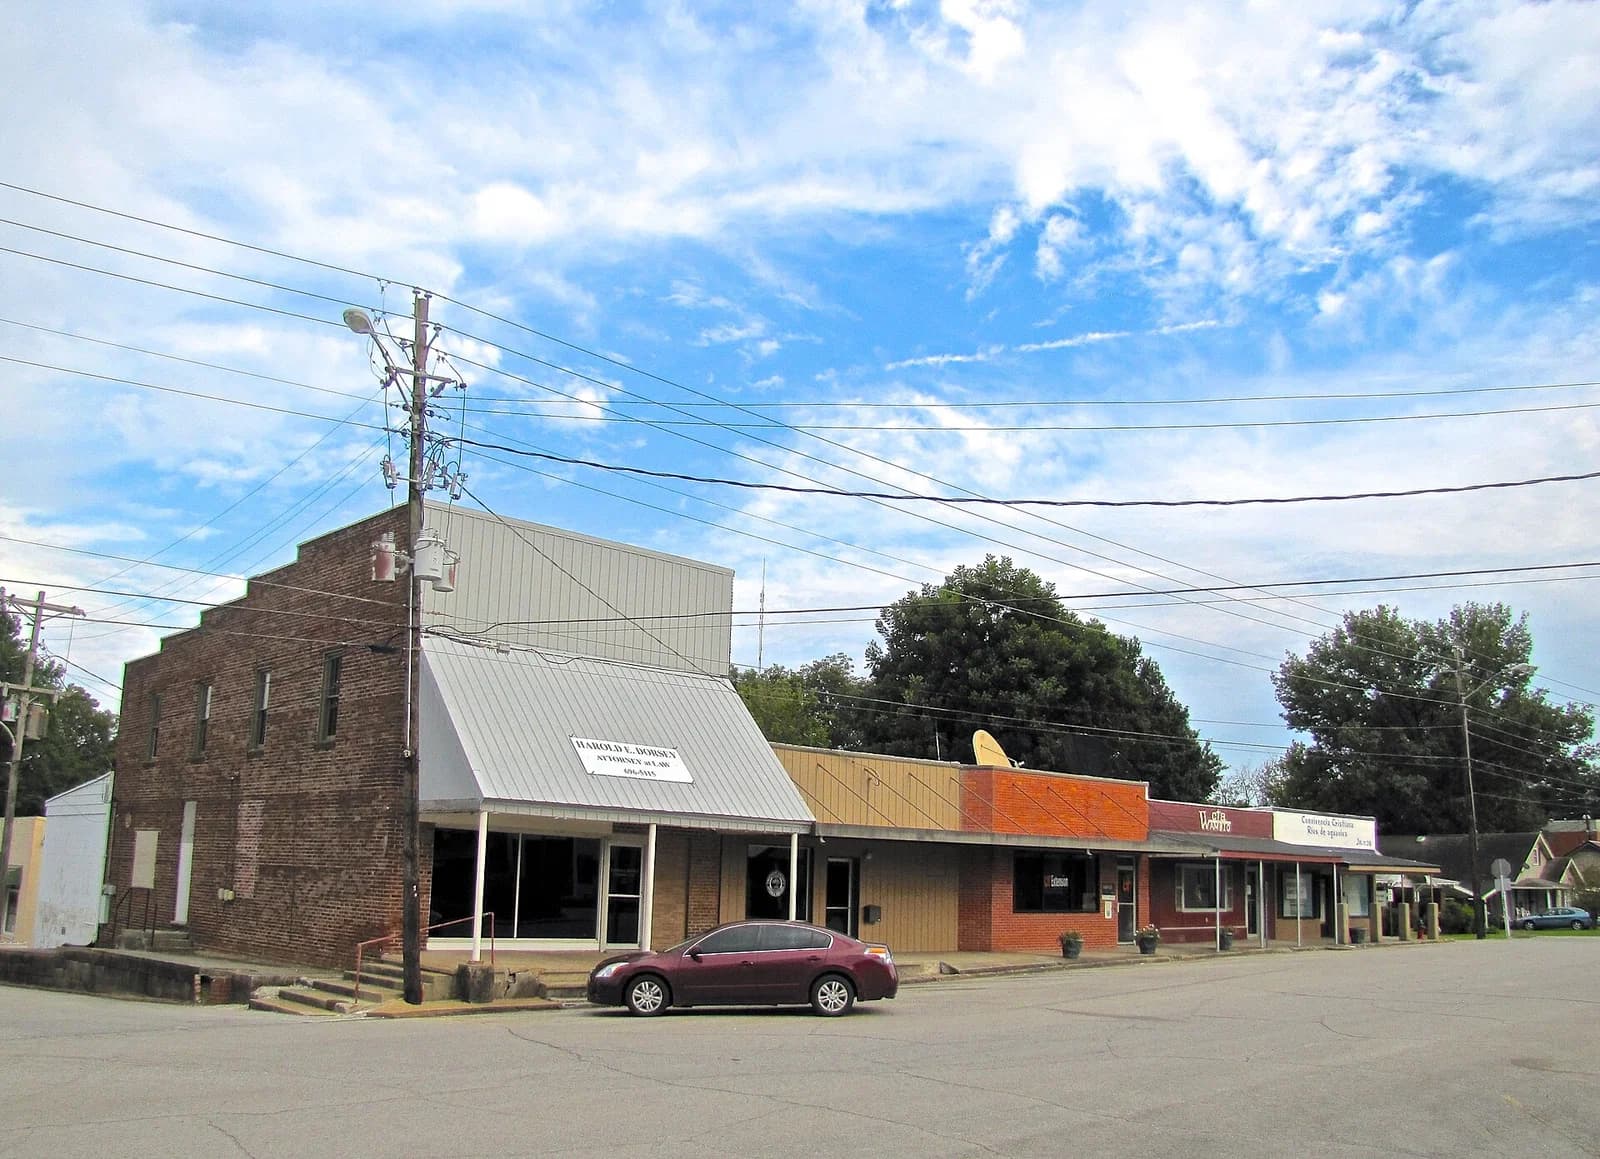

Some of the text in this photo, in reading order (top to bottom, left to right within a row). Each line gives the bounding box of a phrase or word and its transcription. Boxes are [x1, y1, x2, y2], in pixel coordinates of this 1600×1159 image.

[576, 740, 676, 759] HAROLD E. DORSEY
[596, 754, 642, 765] ATTORNEY
